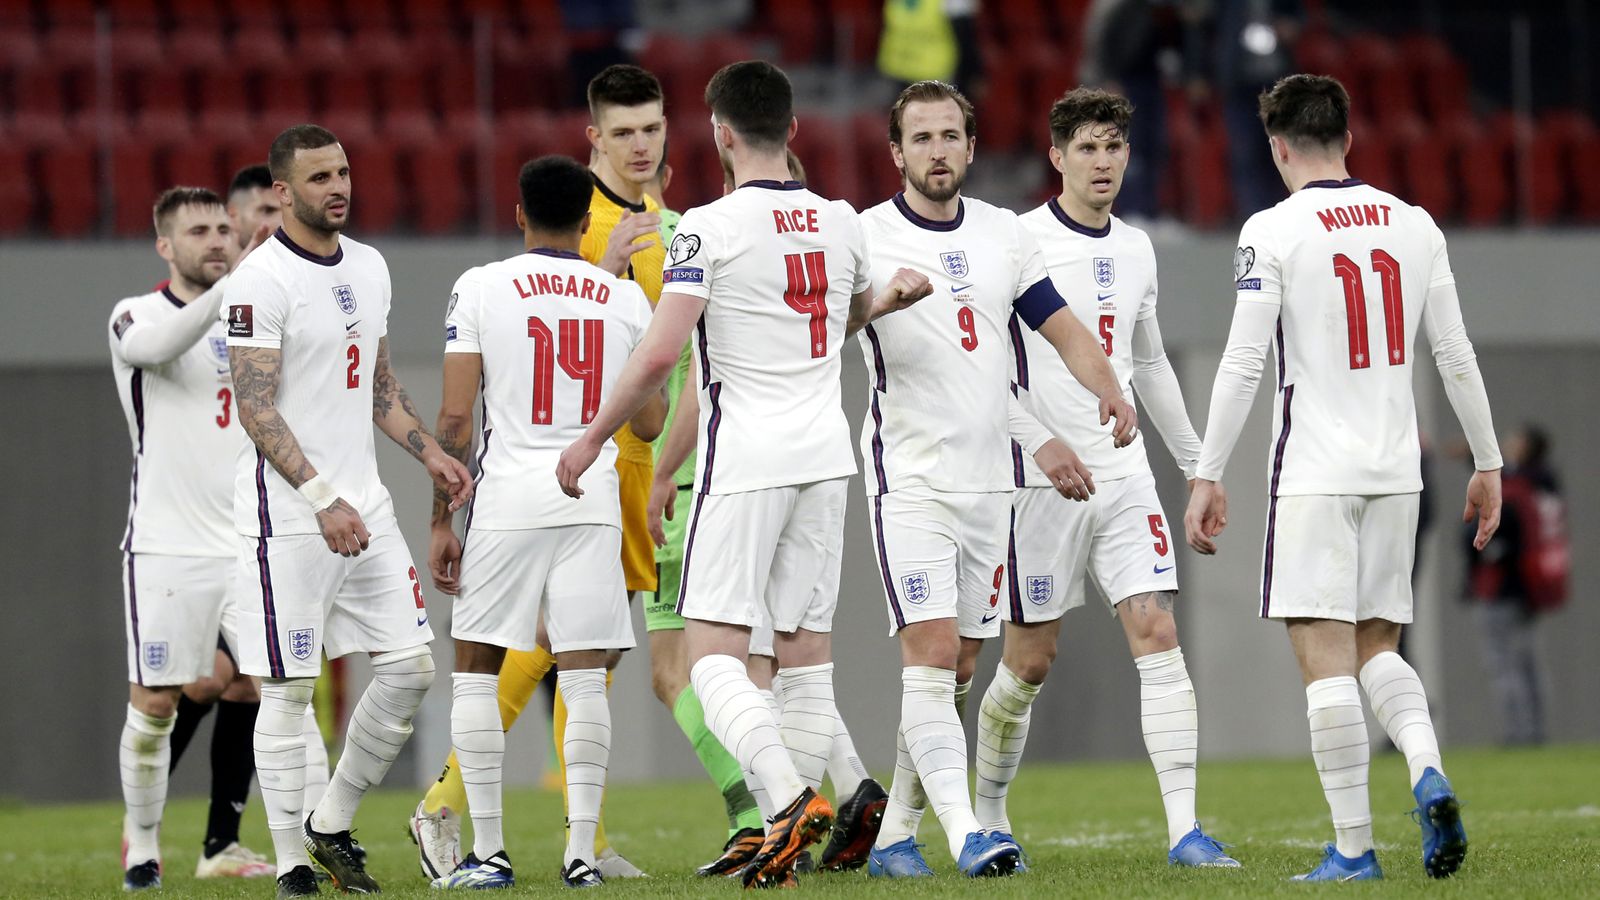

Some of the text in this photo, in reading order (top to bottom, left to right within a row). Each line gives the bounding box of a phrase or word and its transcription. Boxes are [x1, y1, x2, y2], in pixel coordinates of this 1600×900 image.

[773, 209, 819, 234] RICE
[1316, 204, 1391, 232] MOUNT
[512, 273, 610, 305] LINGARD
[672, 271, 703, 279] RESPECT
[783, 251, 829, 359] 4
[1332, 248, 1405, 370] 11
[957, 306, 979, 352] 9
[1099, 315, 1115, 357] 5
[346, 344, 360, 389] 2
[527, 316, 604, 425] 14
[216, 387, 232, 429] 3
[1147, 514, 1169, 557] 5
[408, 566, 425, 609] 2
[989, 563, 1004, 608] 9
